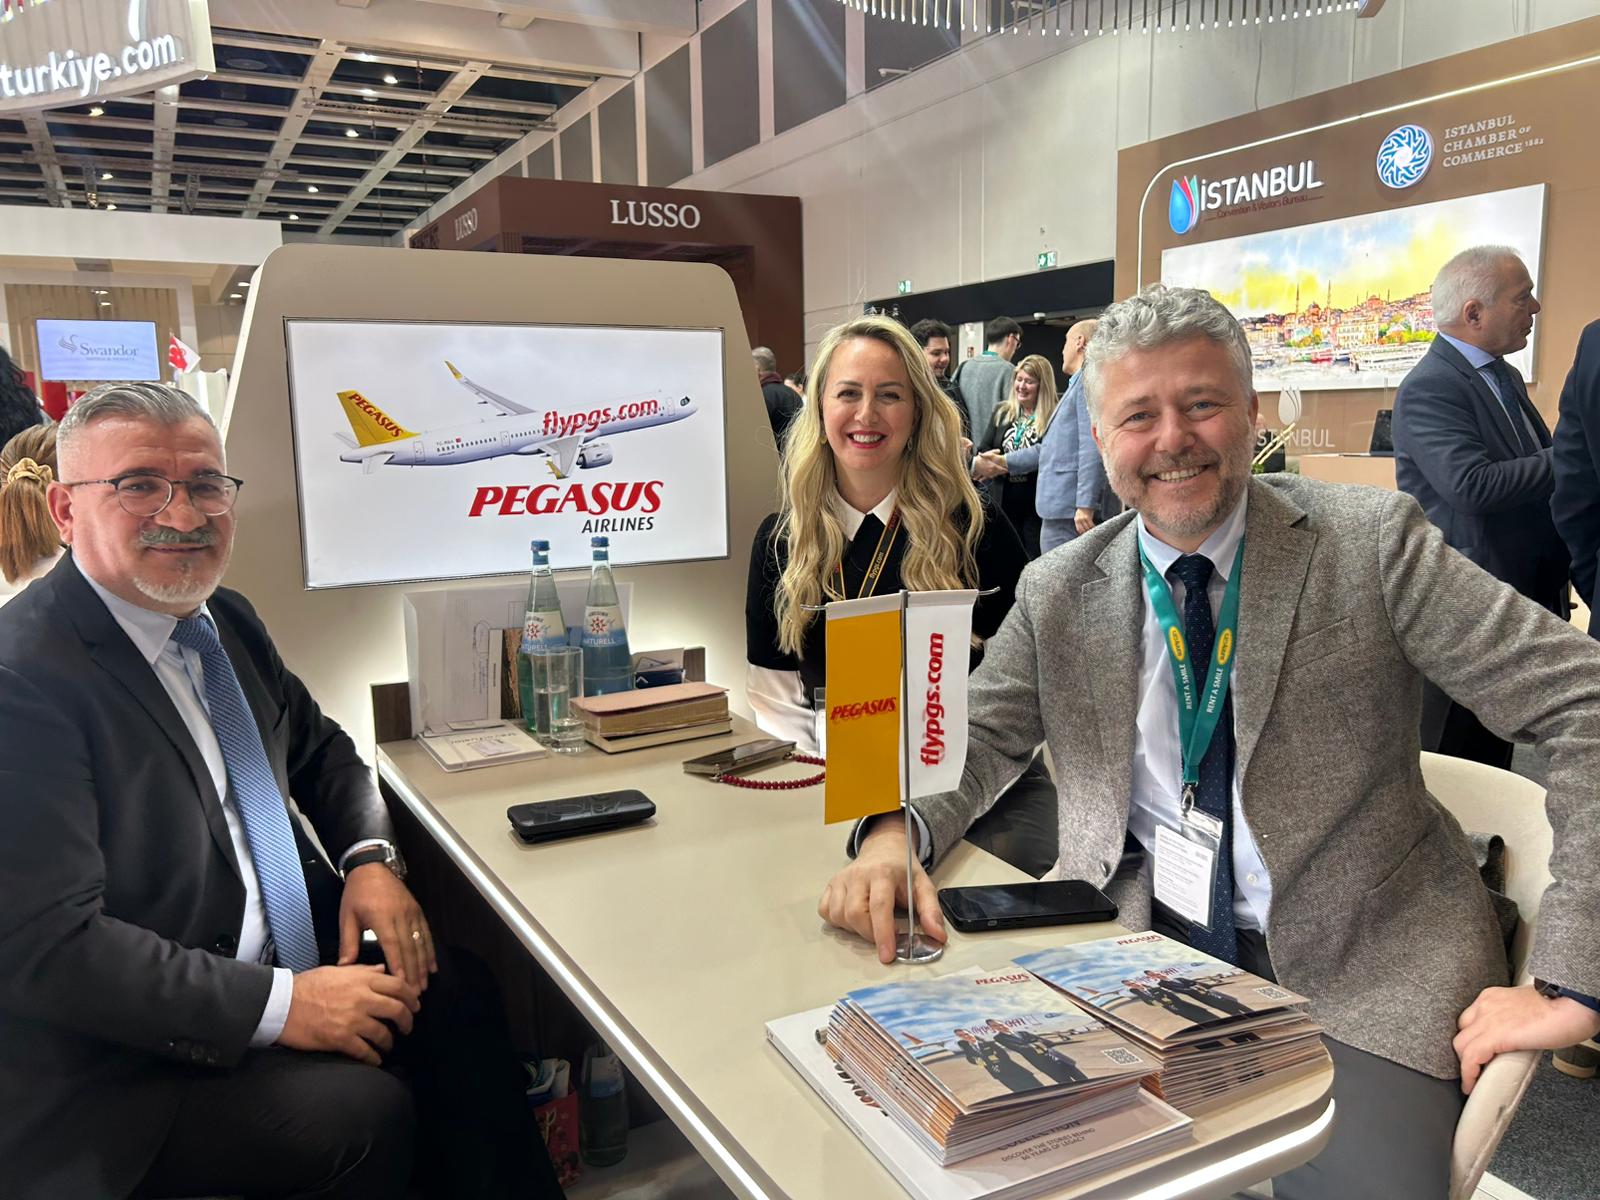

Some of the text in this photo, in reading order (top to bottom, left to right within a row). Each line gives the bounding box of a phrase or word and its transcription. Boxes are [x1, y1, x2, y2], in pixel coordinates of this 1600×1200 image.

[0, 34, 177, 97] turkiye.com
[1444, 115, 1515, 139] ISTANBUL
[1443, 129, 1518, 153] CHAMBER
[1442, 143, 1523, 167] COMMERCE
[454, 208, 478, 241] LUSSO
[611, 200, 700, 228] LUSSO
[79, 342, 139, 356] Swandor
[348, 393, 403, 437] PEGASUS
[543, 400, 658, 438] flypgs.com
[468, 480, 664, 517] PEGASUS
[581, 516, 654, 533] AIRLINES
[1179, 664, 1189, 686] SMILE
[920, 632, 945, 766] flypgs.com
[1182, 691, 1193, 710] RENT
[1206, 668, 1224, 713] RENT A SMILE
[830, 697, 896, 722] PEGASUS
[975, 973, 1030, 985] PEGASUS
